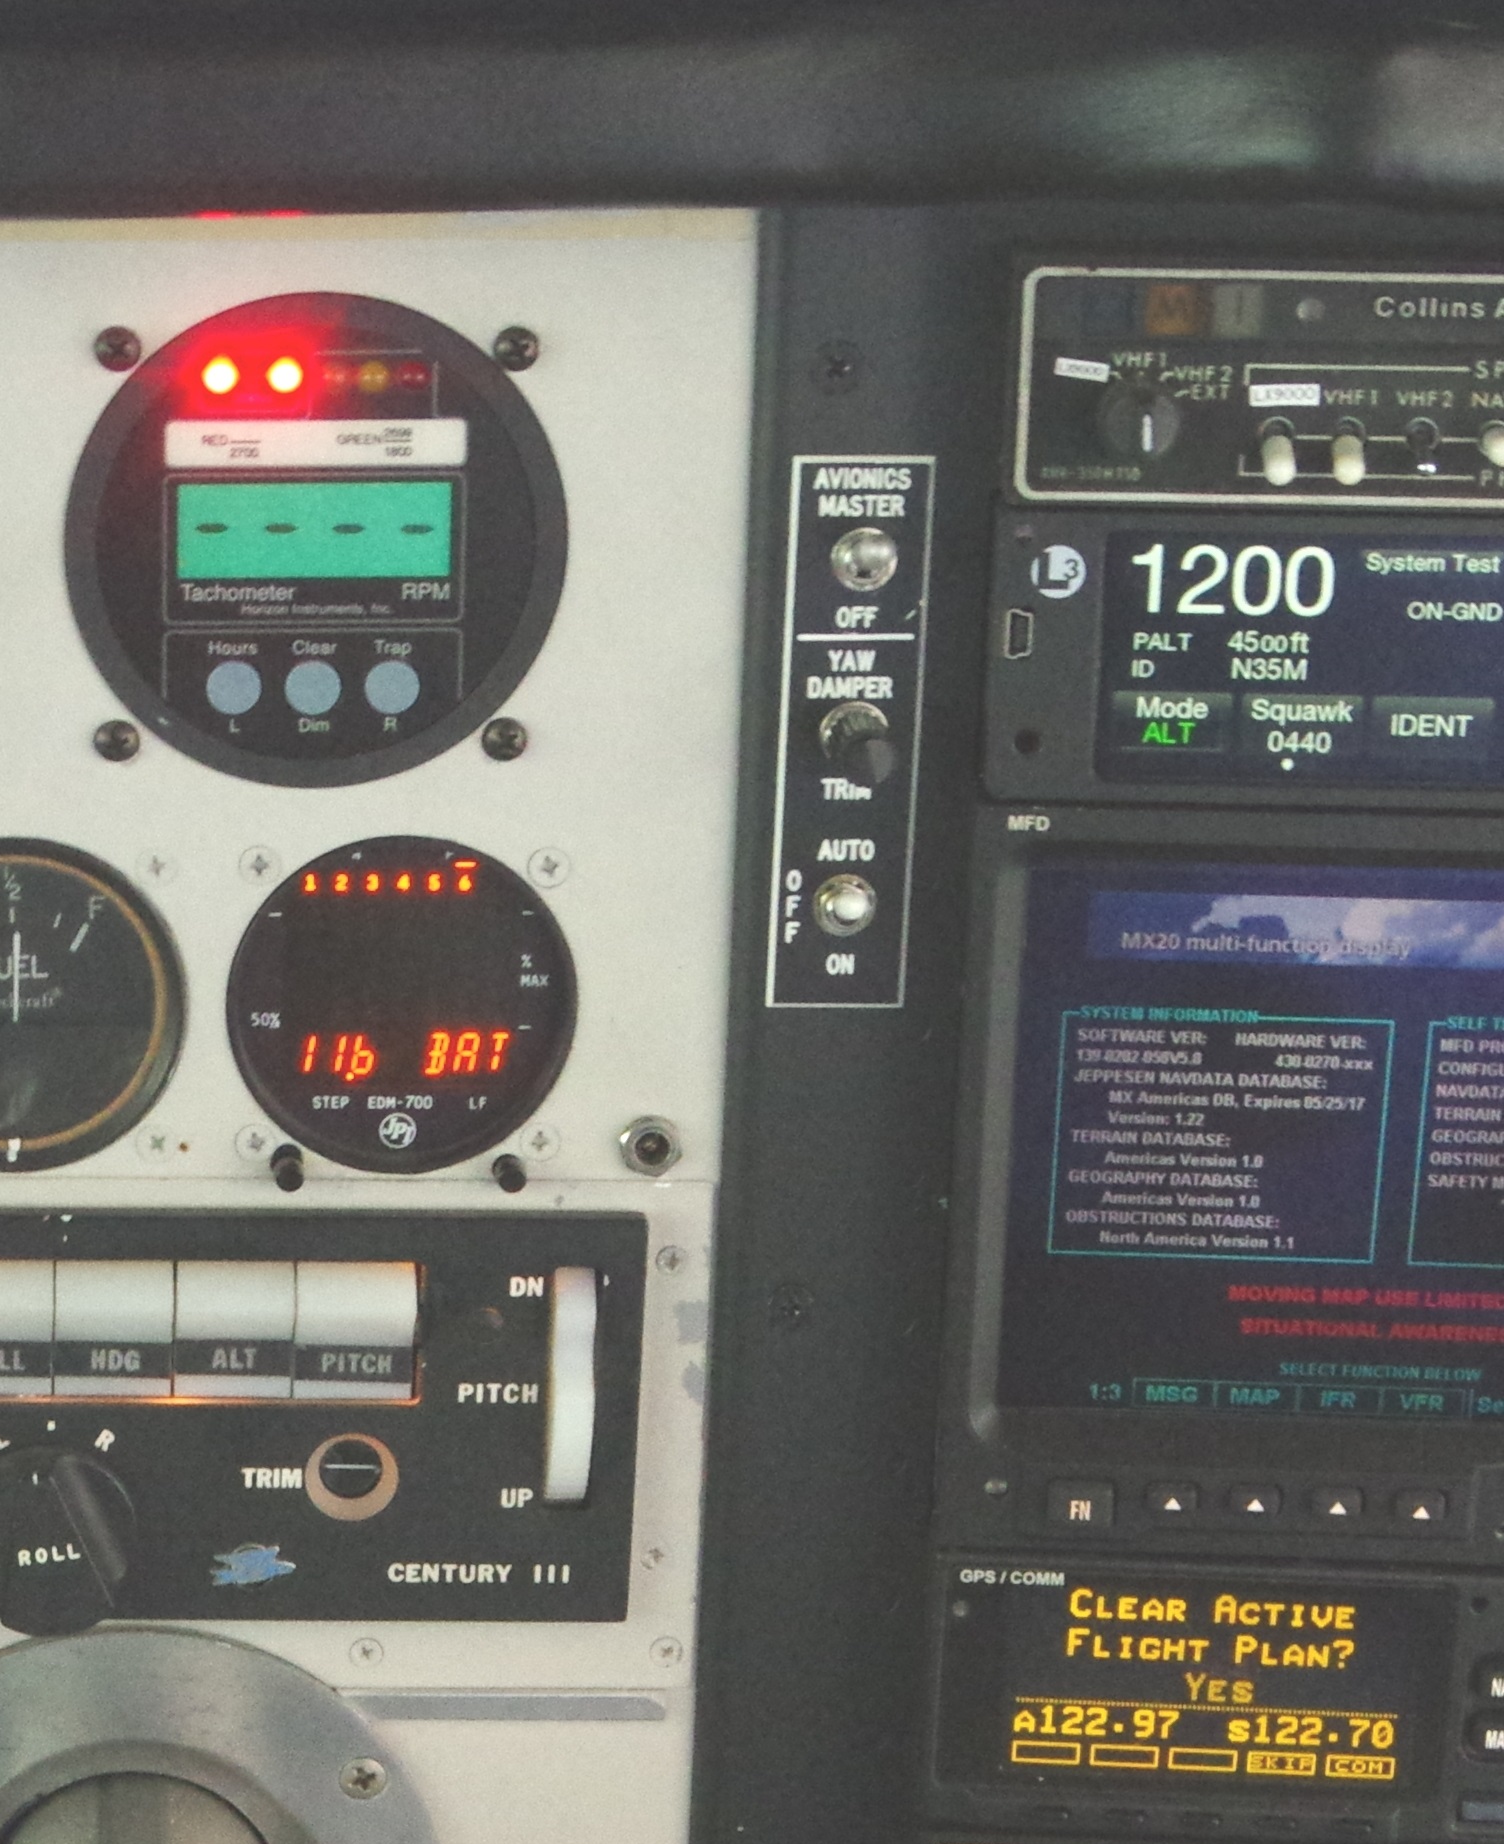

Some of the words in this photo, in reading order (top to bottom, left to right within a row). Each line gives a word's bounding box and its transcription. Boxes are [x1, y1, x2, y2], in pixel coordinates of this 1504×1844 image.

[1375, 297, 1484, 319] Collins
[813, 467, 912, 490] AVIONICS
[819, 495, 905, 518] MASTER
[1132, 543, 1335, 616] 1200
[1366, 553, 1445, 574] System
[1453, 554, 1500, 573] Test
[181, 583, 297, 601] Tachometer
[401, 582, 451, 600] RPM
[835, 607, 879, 628] OFF
[1407, 602, 1503, 621] ON-GND
[208, 640, 258, 656] Hours
[292, 640, 337, 656] Clear
[374, 641, 412, 660] Trap
[1133, 633, 1192, 651] PALT
[828, 650, 876, 672] YAW
[1231, 658, 1307, 680] N35M
[807, 676, 893, 699] DAMPER
[1136, 698, 1208, 719] Mode
[1251, 700, 1352, 724] Squawk
[1142, 723, 1195, 744] ALT
[1391, 714, 1472, 737] IDENT
[1268, 732, 1331, 753] 0440
[1008, 816, 1050, 831] MFD
[818, 840, 875, 861] AUTO
[1121, 933, 1180, 950] MX20
[826, 954, 855, 975] ON
[1080, 1006, 1143, 1021] SYSTEM
[425, 1031, 509, 1075] BAT
[312, 1096, 350, 1109] STEP
[367, 1096, 433, 1110] EDM-700
[510, 1276, 544, 1297] DN
[91, 1350, 141, 1371] HDG
[212, 1348, 257, 1369] ALT
[322, 1352, 392, 1373] PITCH
[457, 1383, 538, 1404] PITCH
[1145, 1386, 1198, 1403] MSG
[1230, 1388, 1281, 1406] MAP
[242, 1467, 302, 1488] TRIM
[18, 1544, 80, 1566] ROLL
[388, 1563, 512, 1583] CENTURY
[533, 1564, 570, 1583] III
[960, 1569, 996, 1585] GPS
[1010, 1571, 1065, 1585] COMM
